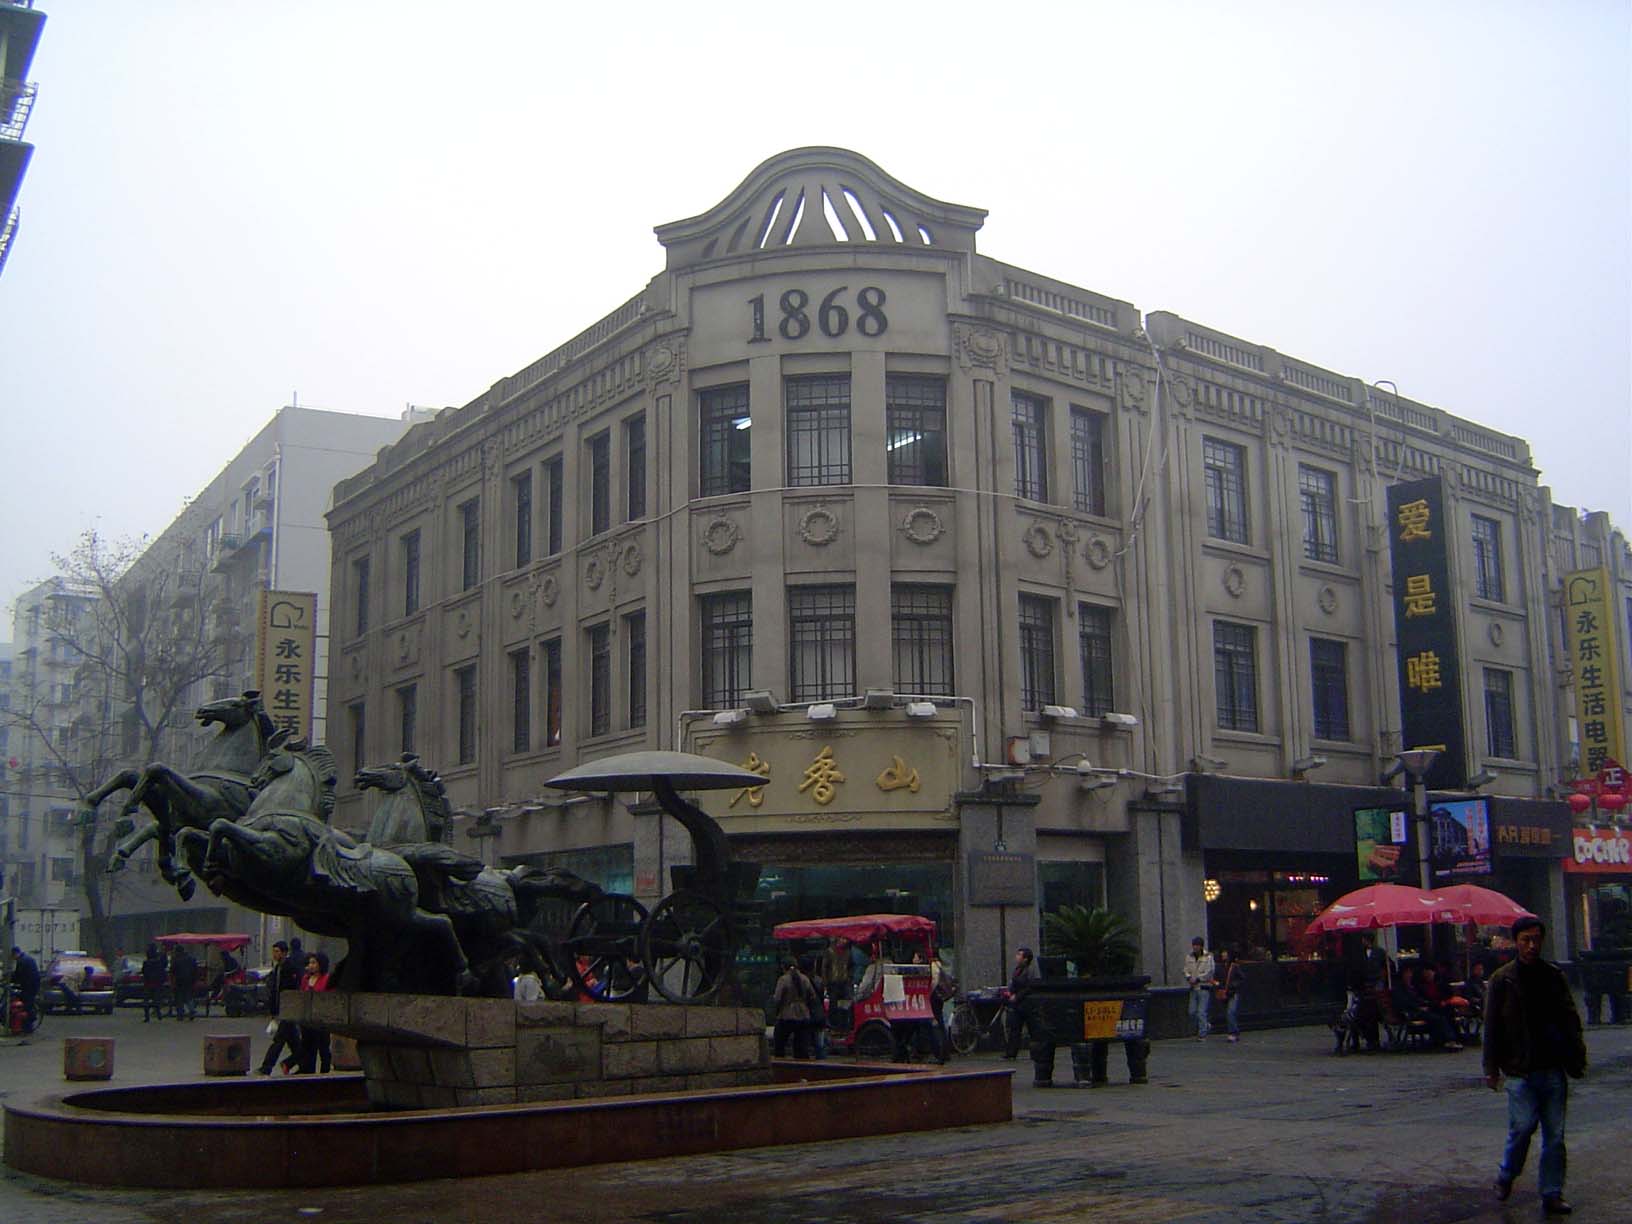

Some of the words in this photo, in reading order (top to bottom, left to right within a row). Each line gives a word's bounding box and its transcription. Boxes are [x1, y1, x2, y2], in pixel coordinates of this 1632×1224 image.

[746, 286, 888, 344] 1868
[1576, 611, 1609, 773] 永乐生活电器
